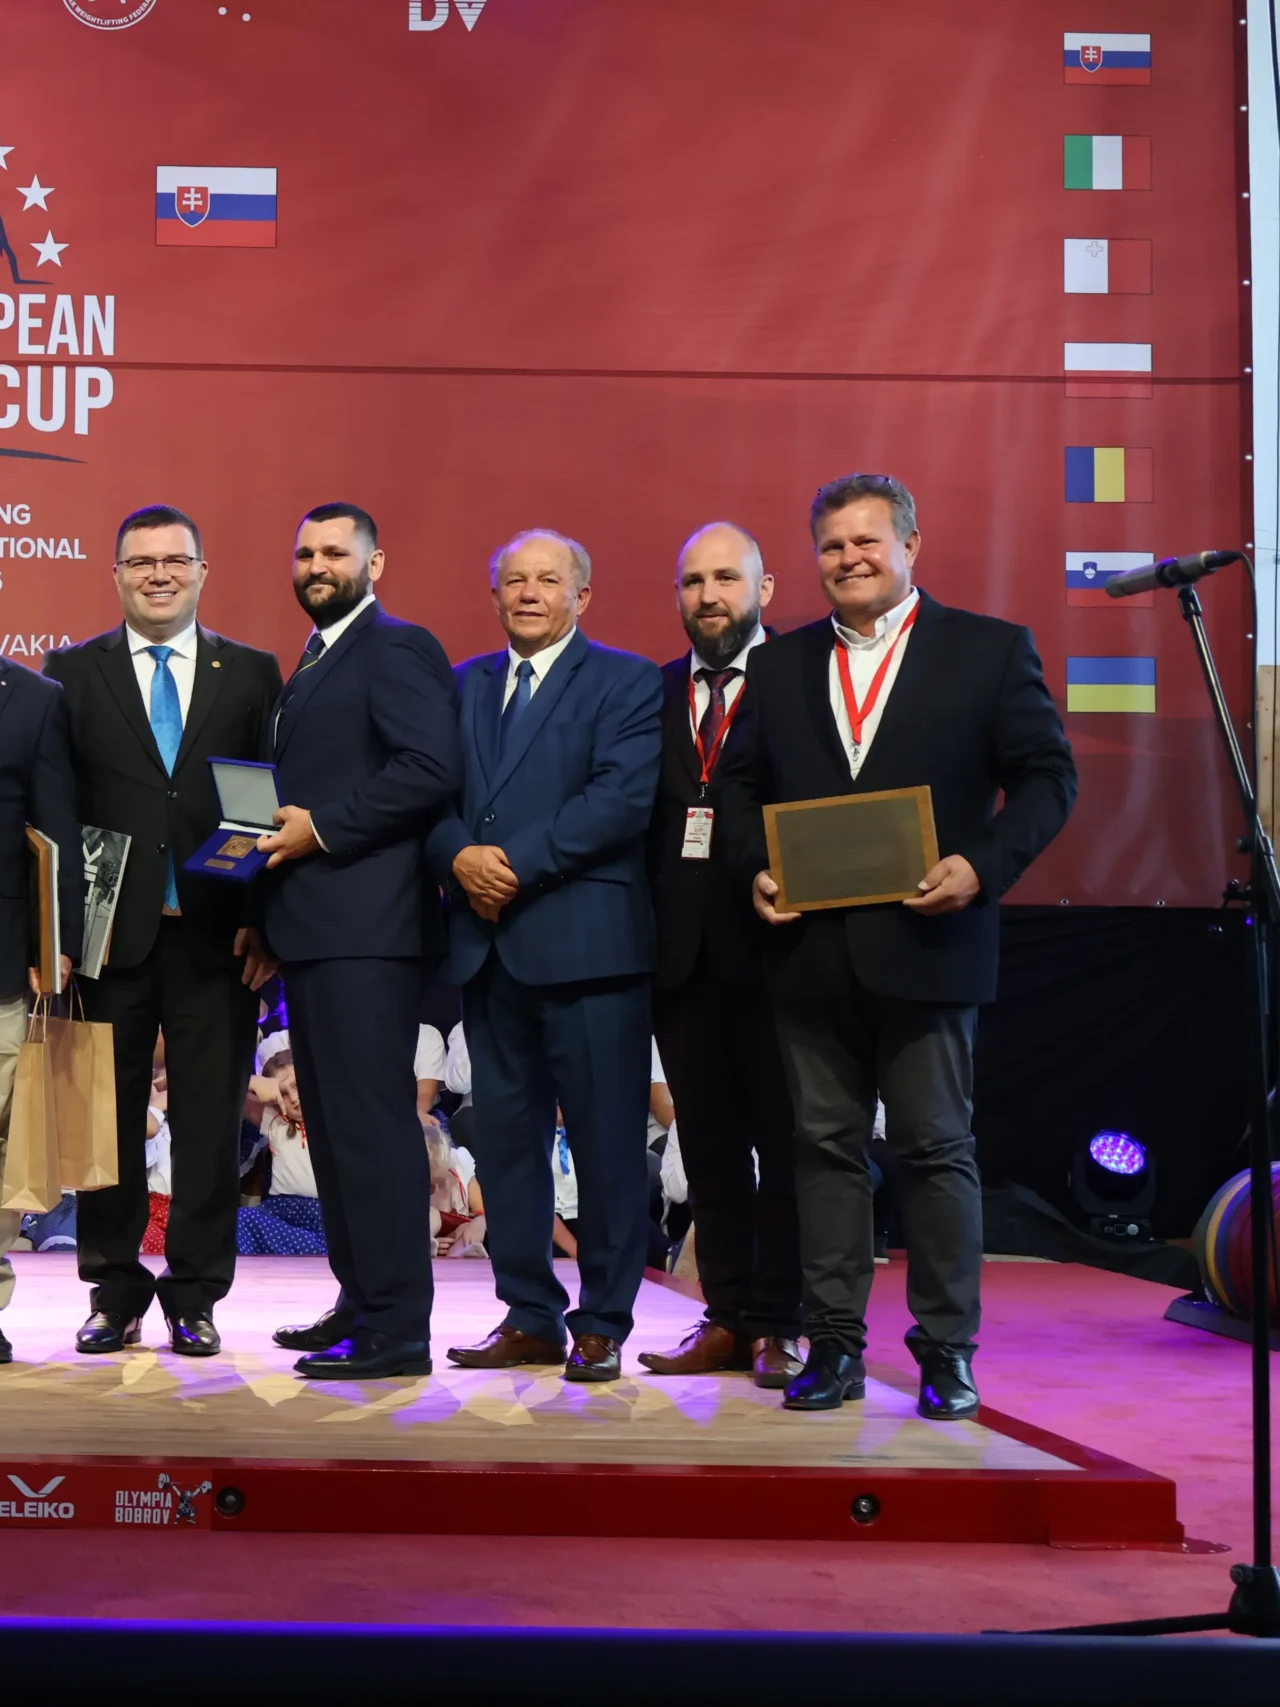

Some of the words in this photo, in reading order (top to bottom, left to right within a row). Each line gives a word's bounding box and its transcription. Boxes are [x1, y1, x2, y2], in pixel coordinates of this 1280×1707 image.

[75, 6, 129, 26] WEIGHTLIFTING
[115, 1491, 172, 1507] OLYMPIA
[115, 1507, 170, 1524] BOBROV
